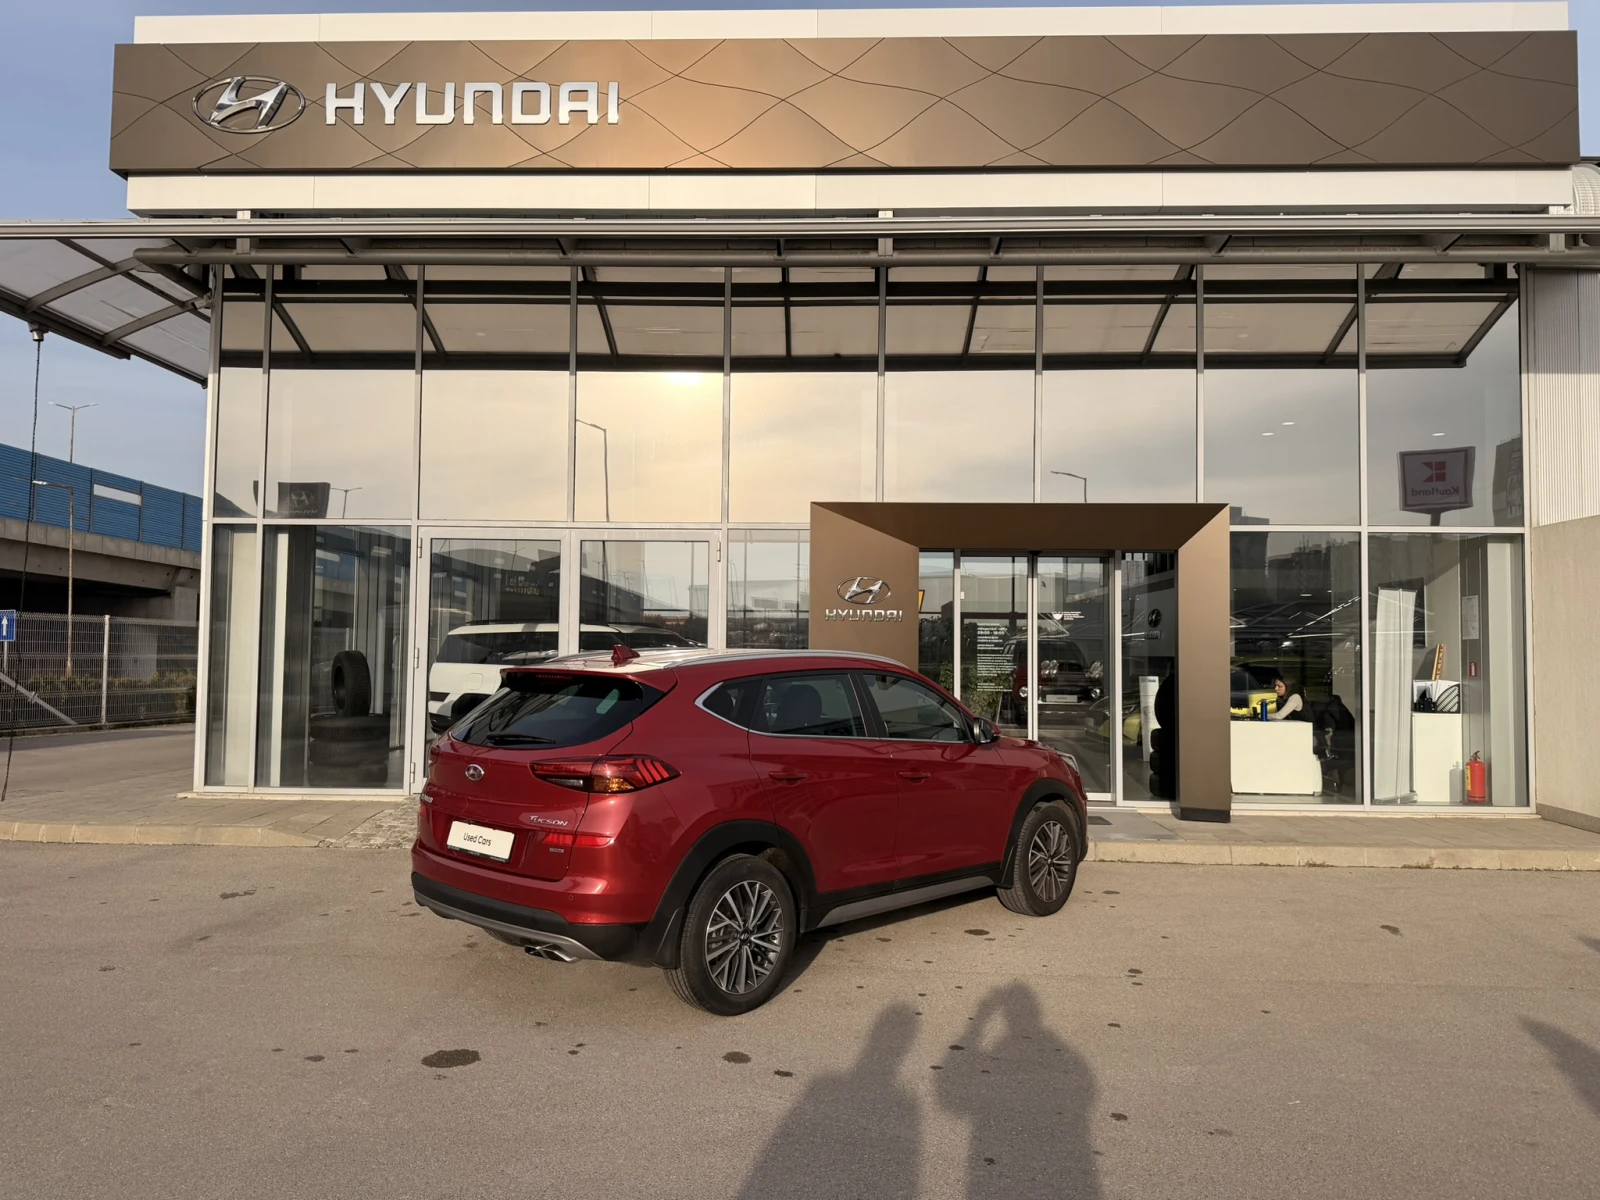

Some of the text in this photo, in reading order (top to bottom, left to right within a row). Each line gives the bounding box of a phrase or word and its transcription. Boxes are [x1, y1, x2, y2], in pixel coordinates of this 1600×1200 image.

[325, 81, 619, 125] HYUNDAI
[825, 608, 903, 621] HYUNDAI
[529, 815, 568, 826] TUCSON
[463, 832, 492, 847] Used Cars
